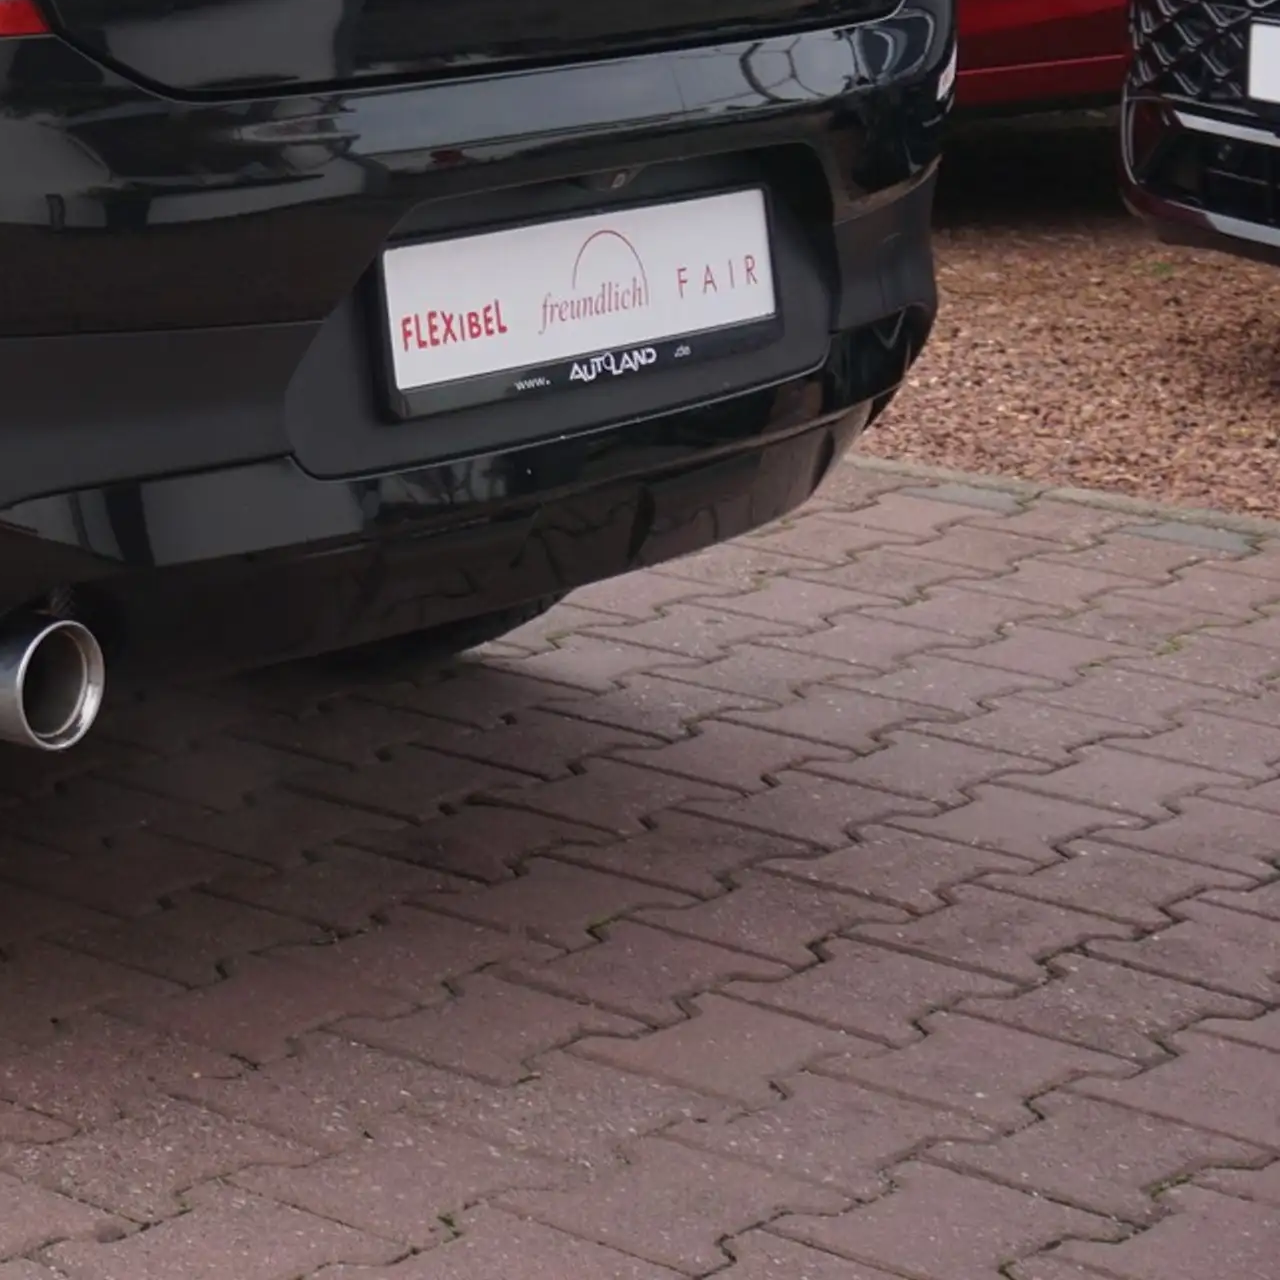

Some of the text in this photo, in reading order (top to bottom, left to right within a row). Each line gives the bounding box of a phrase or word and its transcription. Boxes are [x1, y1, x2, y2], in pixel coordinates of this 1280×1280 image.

[401, 254, 758, 352] FLEXIBEL freundlich FAIR
[514, 376, 551, 391] www.
[569, 347, 657, 382] AUTOLAND
